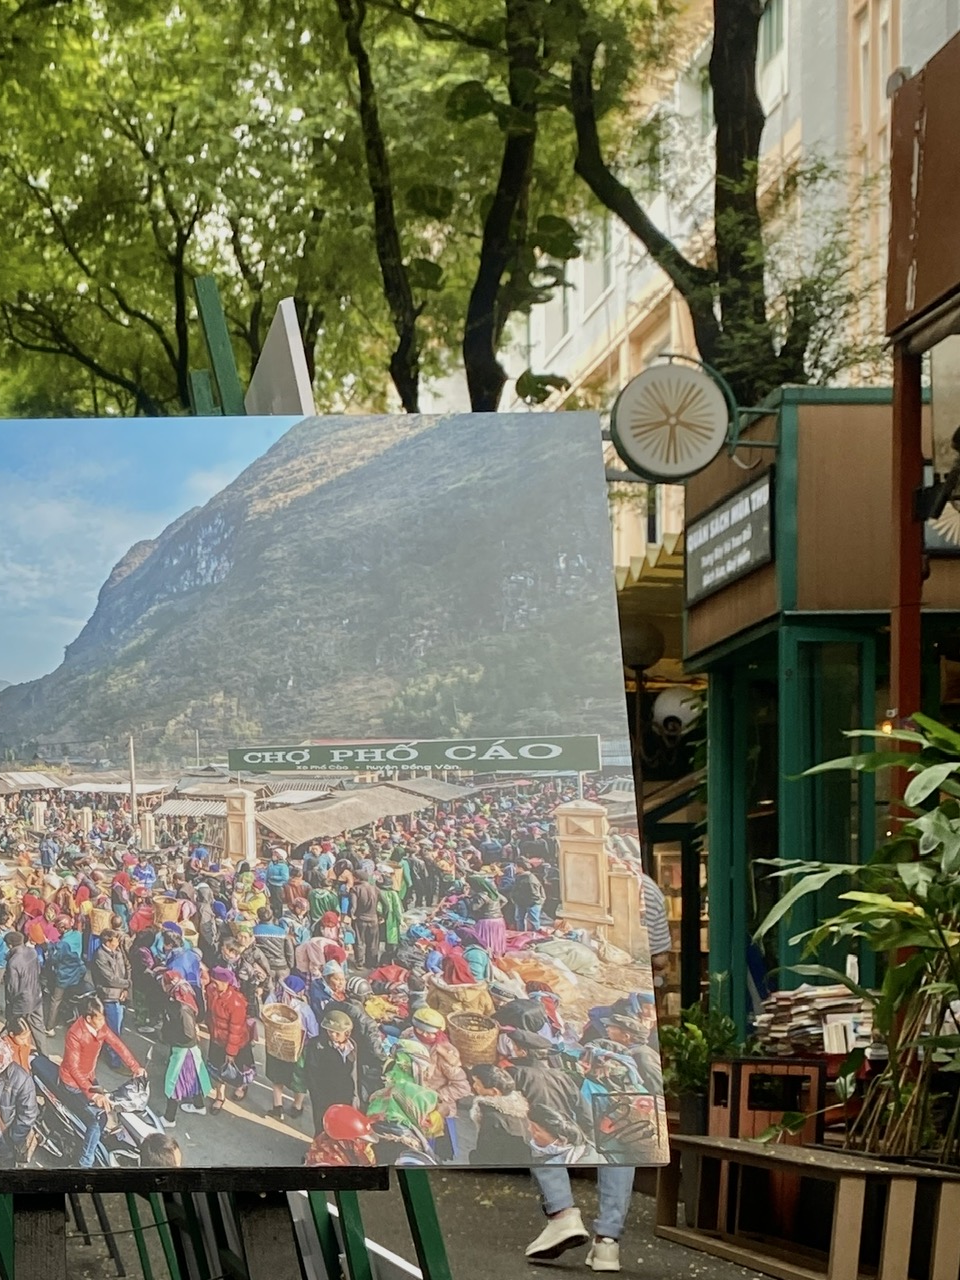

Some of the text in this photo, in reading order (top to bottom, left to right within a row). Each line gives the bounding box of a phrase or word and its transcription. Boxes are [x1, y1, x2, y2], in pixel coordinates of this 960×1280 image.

[243, 740, 563, 765] CHỢ PHỐ CÁO
